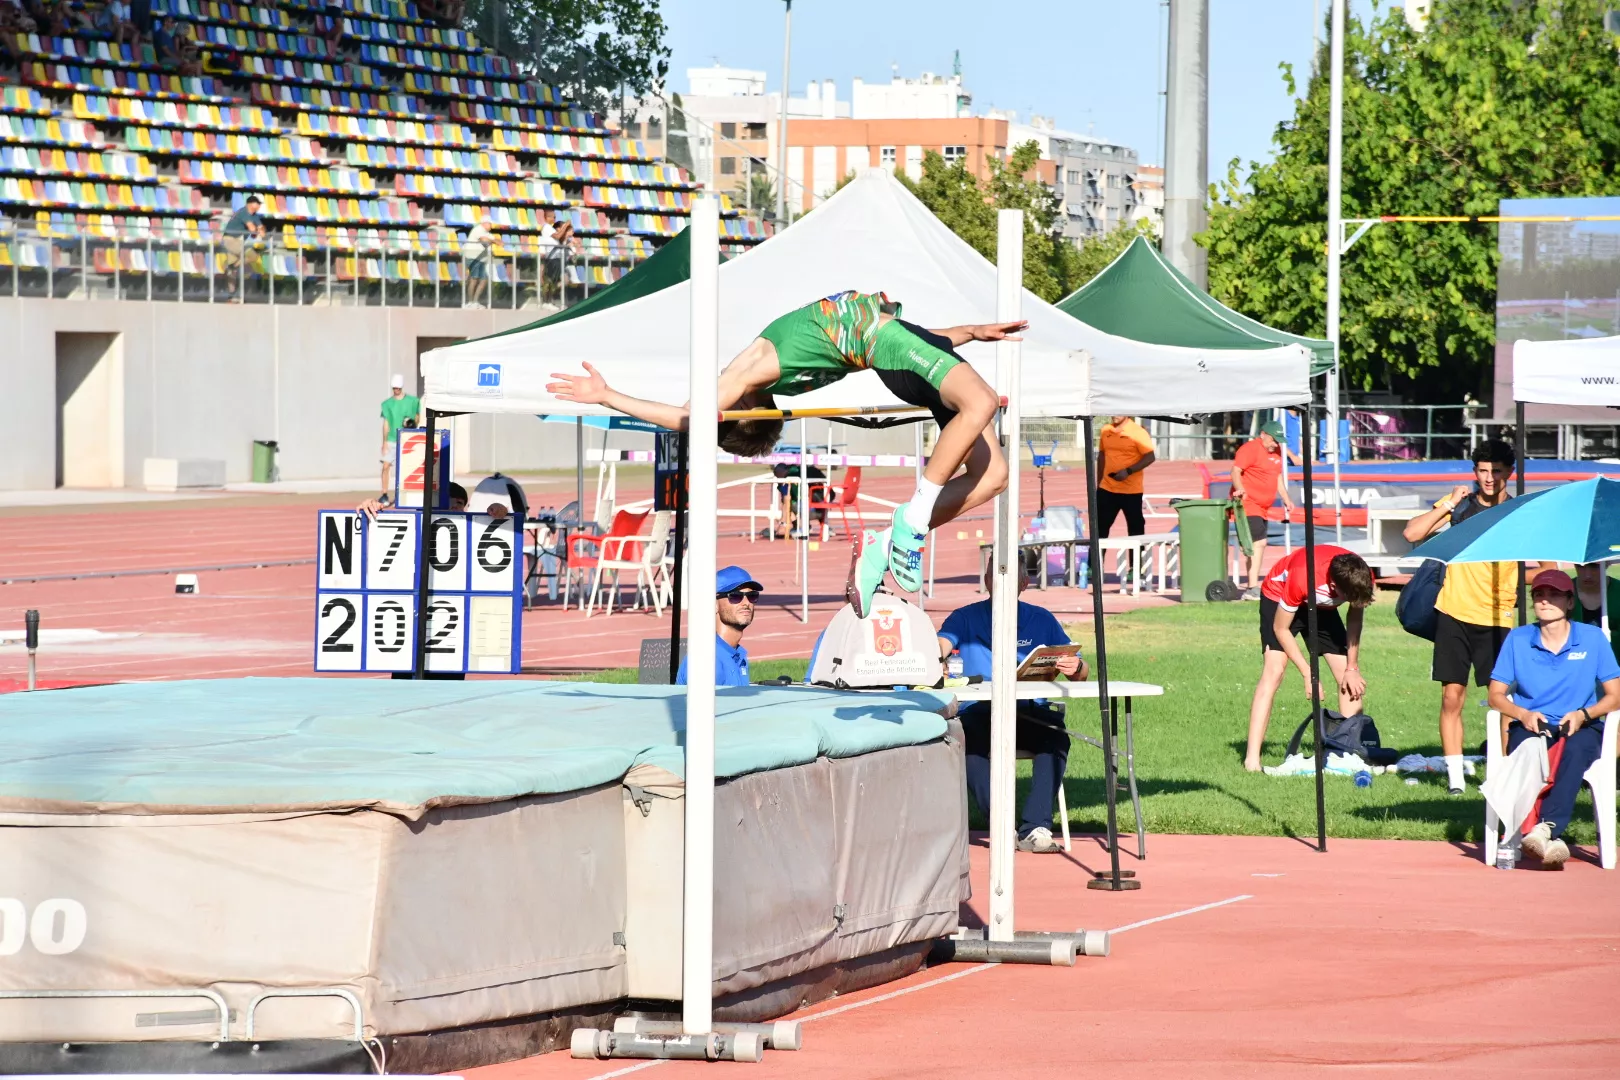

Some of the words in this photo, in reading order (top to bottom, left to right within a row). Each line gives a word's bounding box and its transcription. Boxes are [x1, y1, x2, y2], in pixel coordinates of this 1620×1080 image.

[401, 434, 440, 490] 2
[1300, 488, 1382, 504] DIMA
[321, 597, 459, 653] 202
